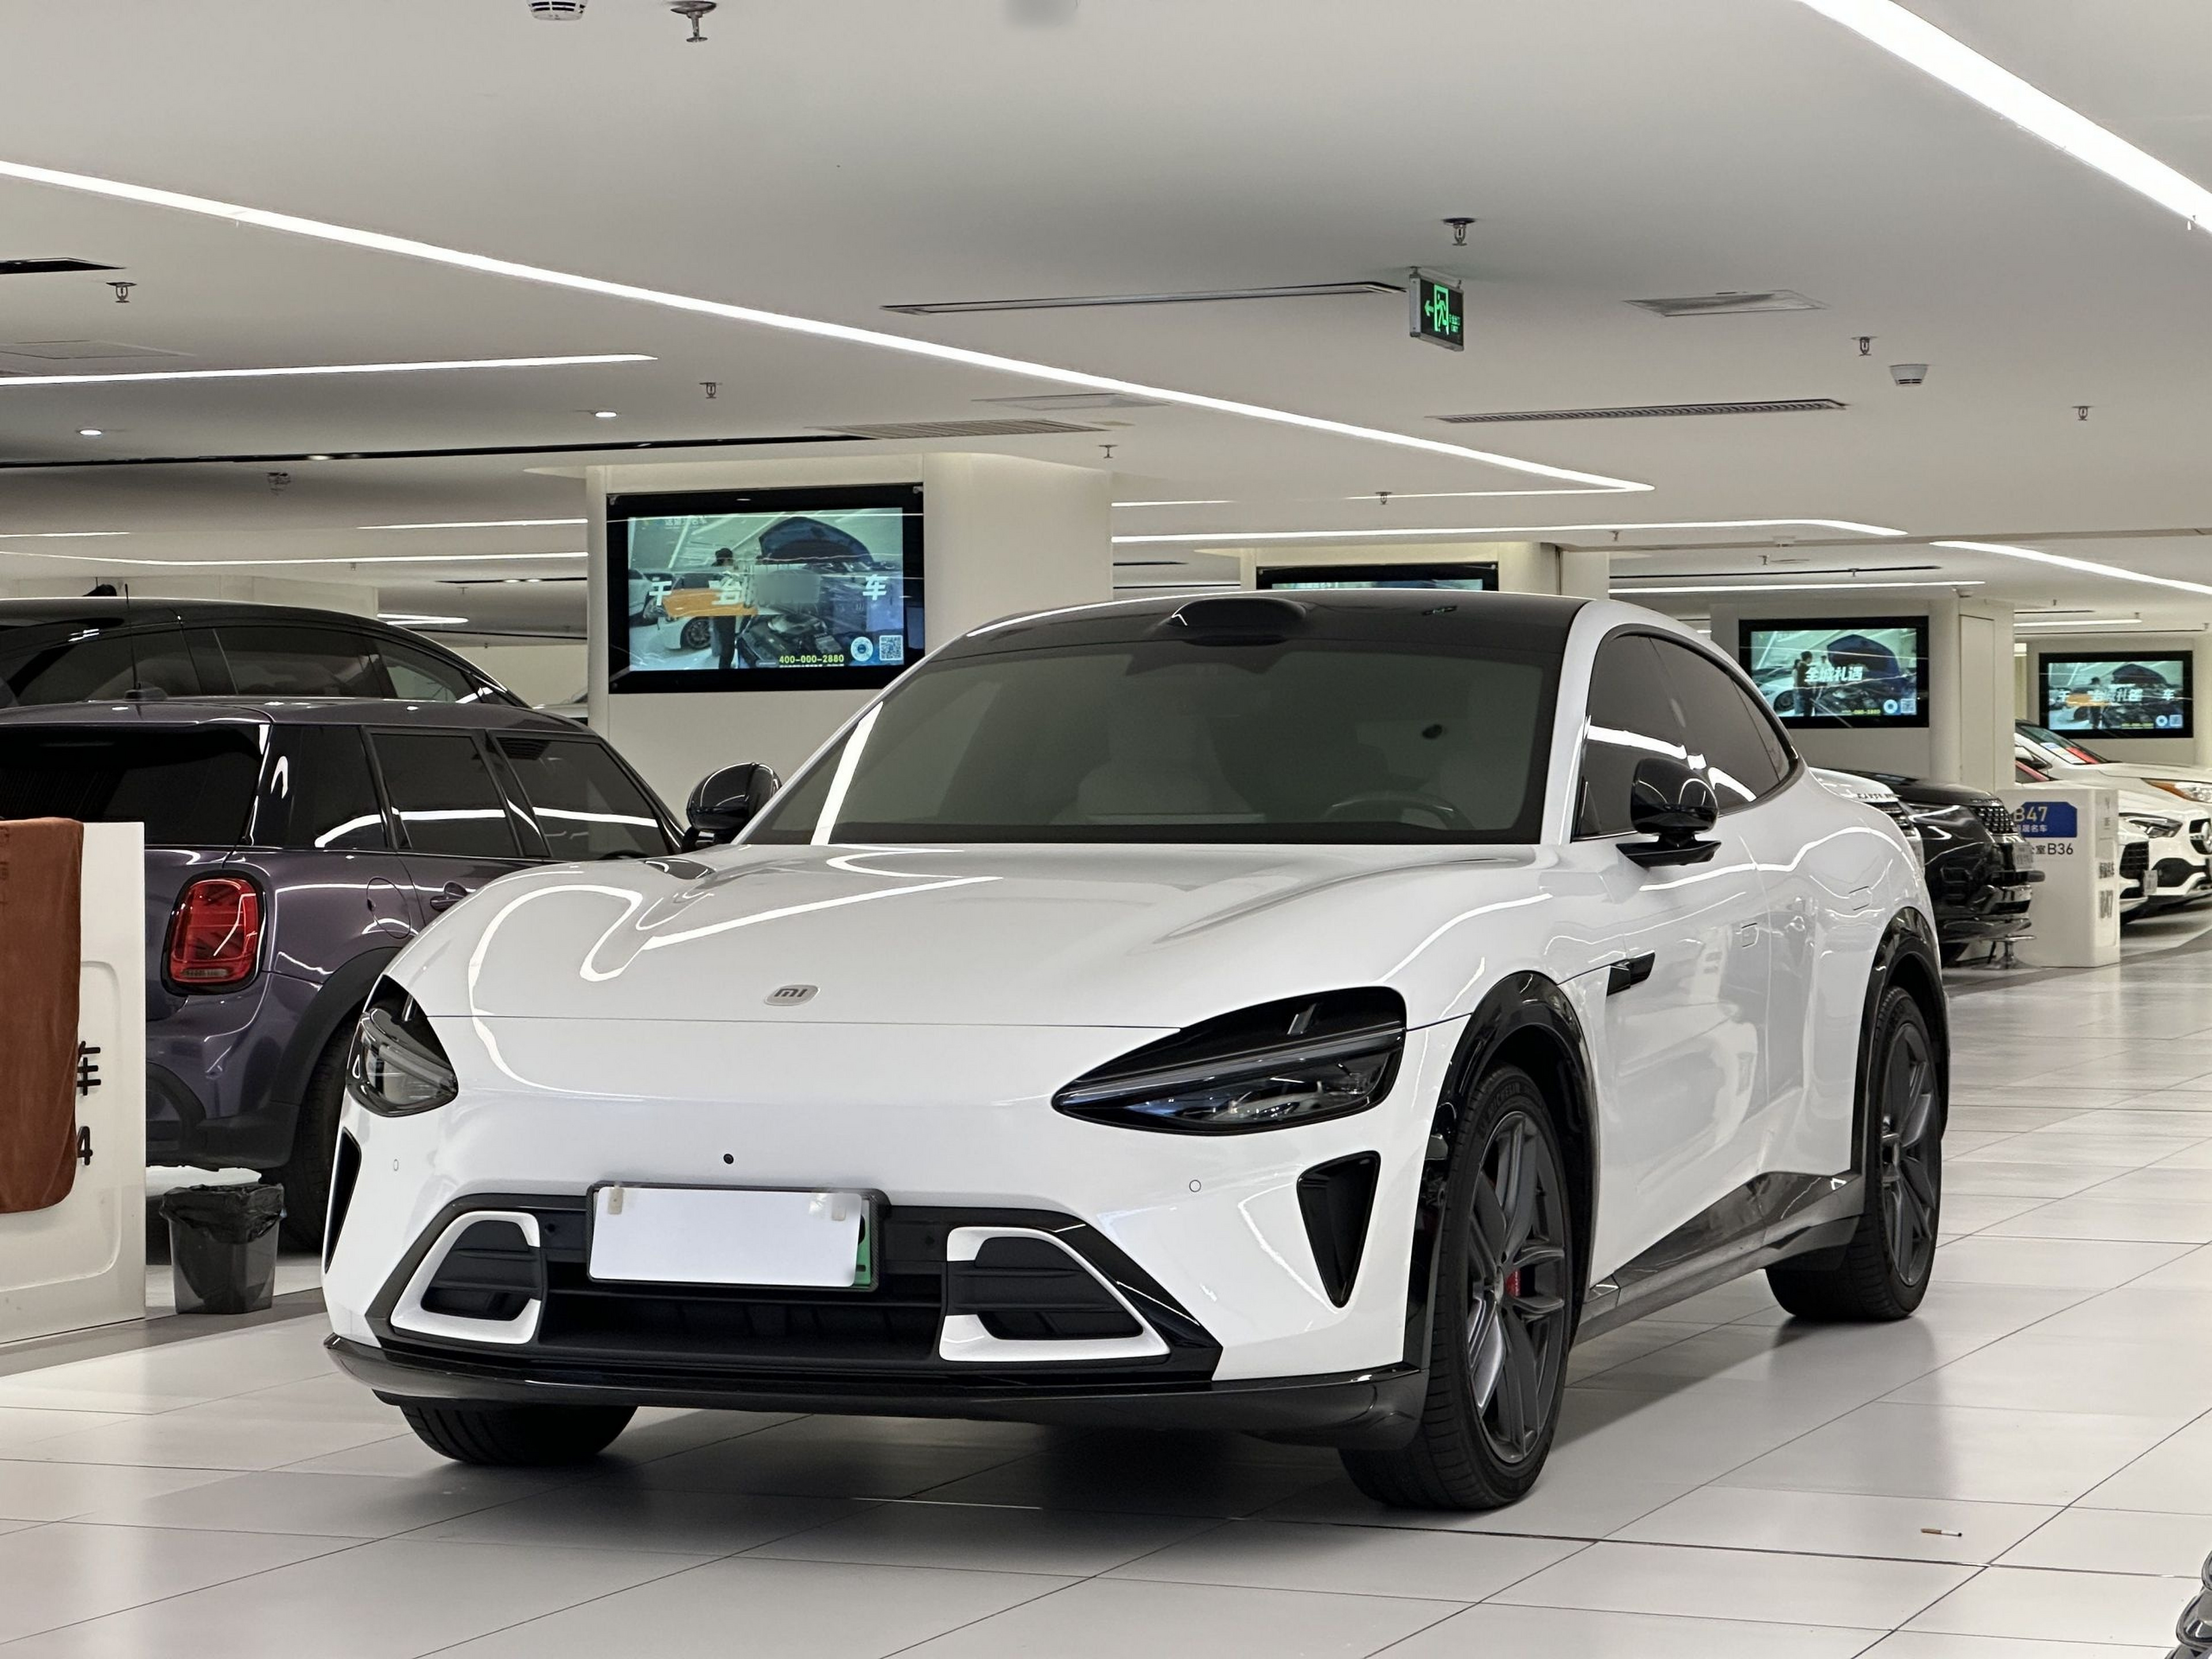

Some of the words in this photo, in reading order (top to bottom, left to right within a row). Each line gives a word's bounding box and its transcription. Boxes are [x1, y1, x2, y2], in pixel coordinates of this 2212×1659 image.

[862, 574, 888, 601] 车
[779, 654, 844, 664] 400-000-2880
[2013, 806, 2048, 822] B47
